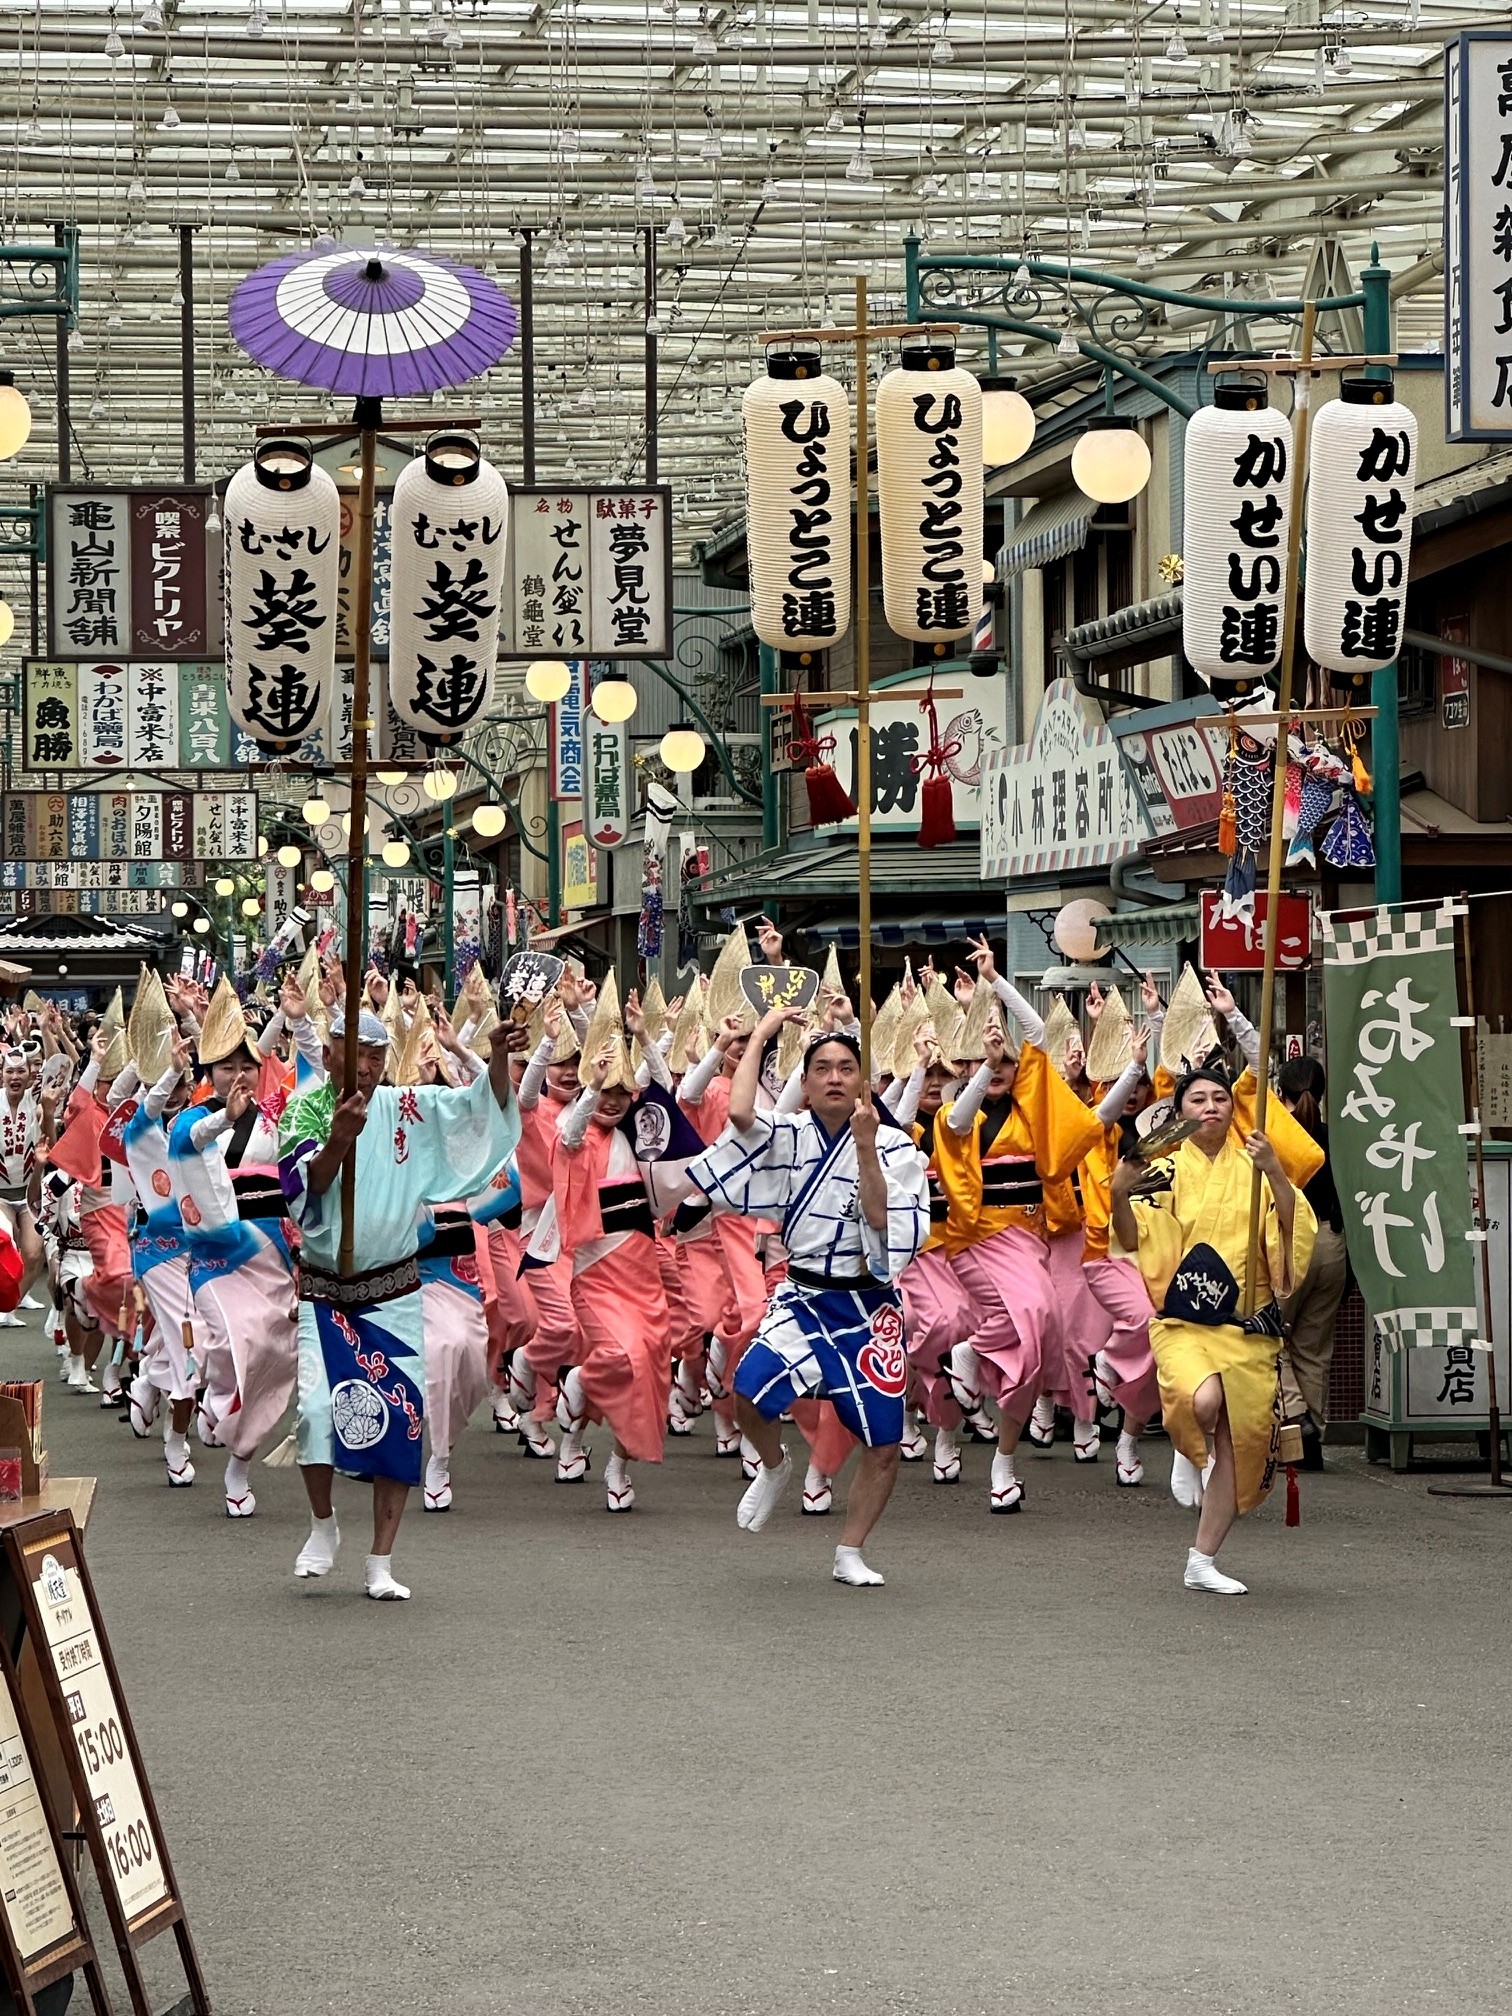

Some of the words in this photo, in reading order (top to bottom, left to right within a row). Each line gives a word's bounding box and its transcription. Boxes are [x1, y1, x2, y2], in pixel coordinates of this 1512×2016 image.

[411, 513, 502, 552] むさし
[533, 497, 573, 513] 名物
[596, 498, 658, 520] 駄菓子
[779, 399, 837, 637] ひょっとこ連
[912, 393, 970, 630] ひょっとこ連
[238, 518, 331, 561] むさし
[1220, 433, 1286, 664] かせい連
[1341, 428, 1411, 660] かせい連
[606, 522, 651, 647] 夢見堂
[241, 568, 328, 737] 葵連
[409, 558, 496, 728] 葵連
[33, 697, 73, 762] 魚勝
[593, 733, 620, 820] わかば薬局
[1011, 758, 1115, 848] 小林理容所
[48, 814, 64, 857] 助六屋
[111, 796, 127, 857] 肉のおほみ
[134, 805, 153, 857] 夕陽館
[1340, 977, 1446, 1278] おみやげ
[1176, 1271, 1229, 1310] かせい連
[59, 1639, 92, 1672] 受付終了時間
[67, 1695, 84, 1720] 平日
[78, 1718, 122, 1775] 15:00
[107, 1819, 151, 1878] 16:00
